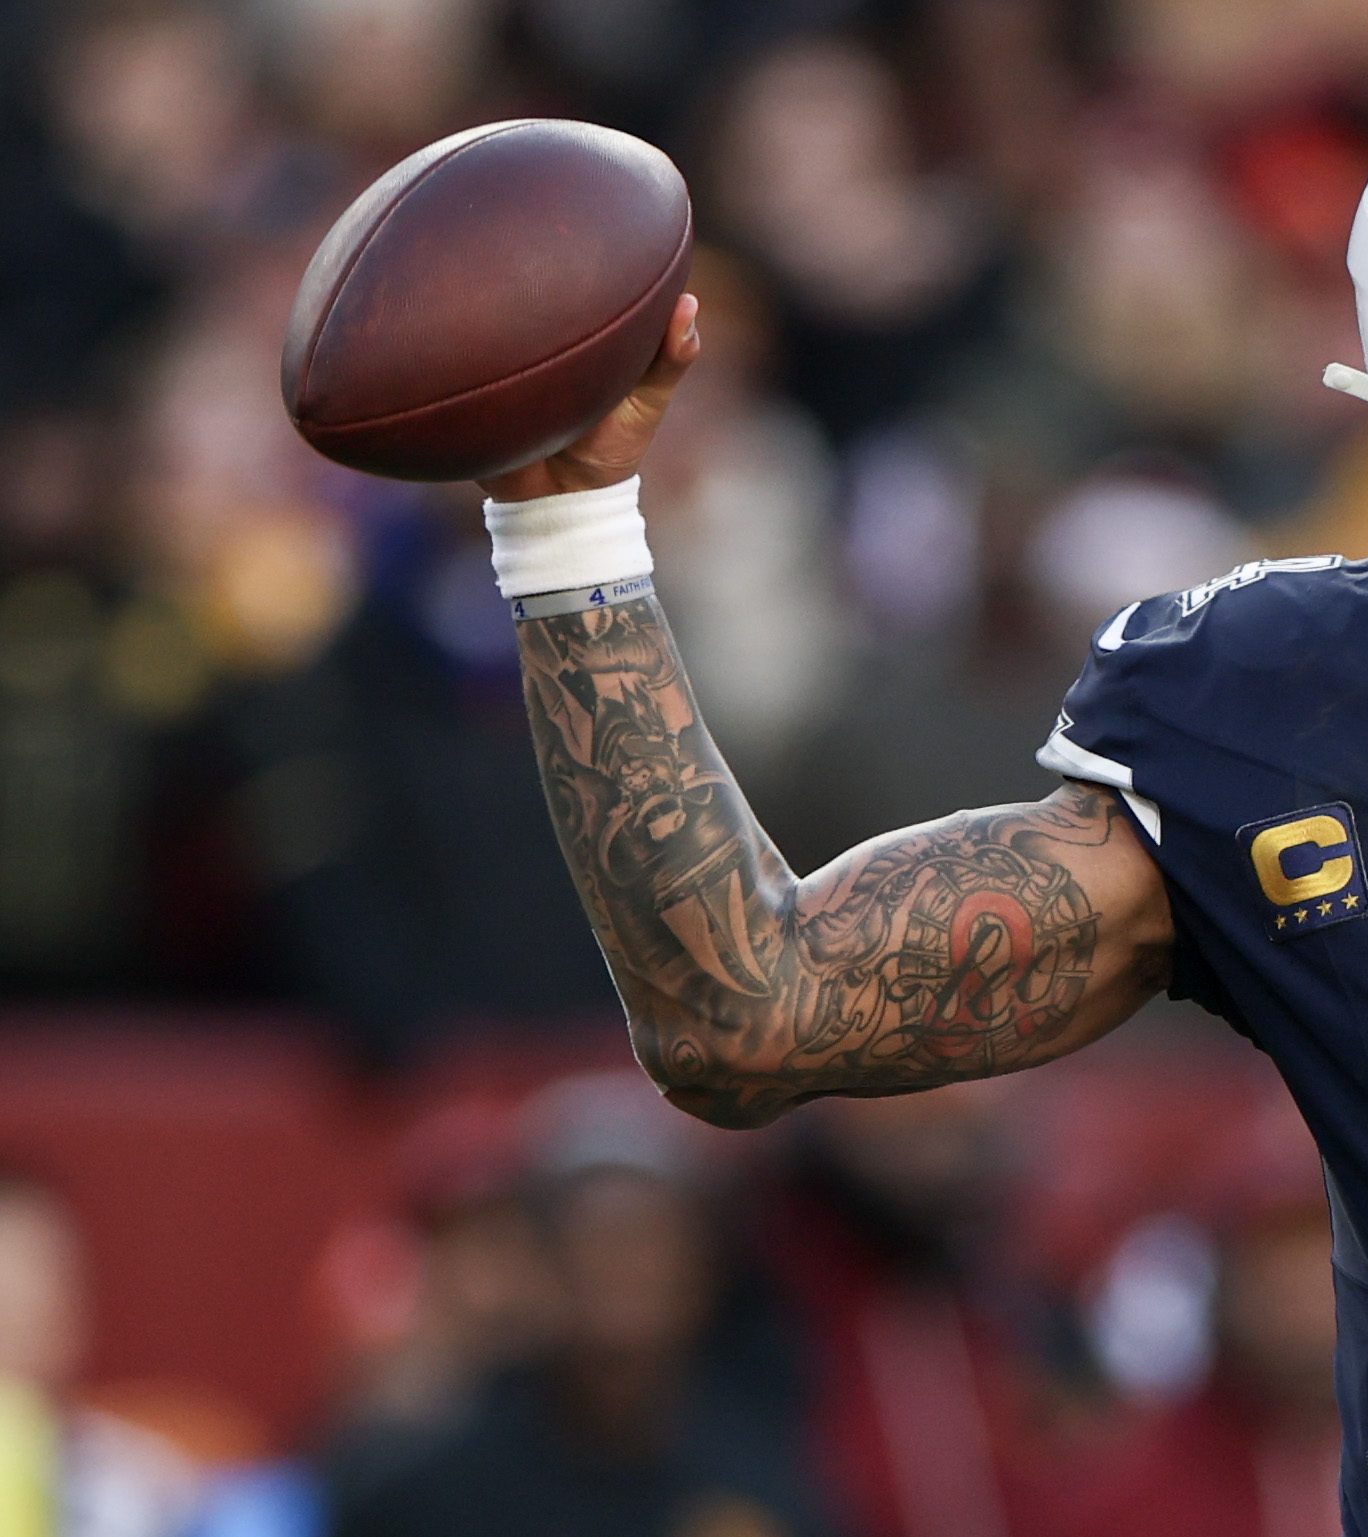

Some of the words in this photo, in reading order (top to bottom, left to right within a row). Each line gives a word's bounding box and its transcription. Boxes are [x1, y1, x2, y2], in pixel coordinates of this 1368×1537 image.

[589, 587, 608, 606] 4
[613, 581, 641, 597] FAITH
[1251, 815, 1353, 907] C
